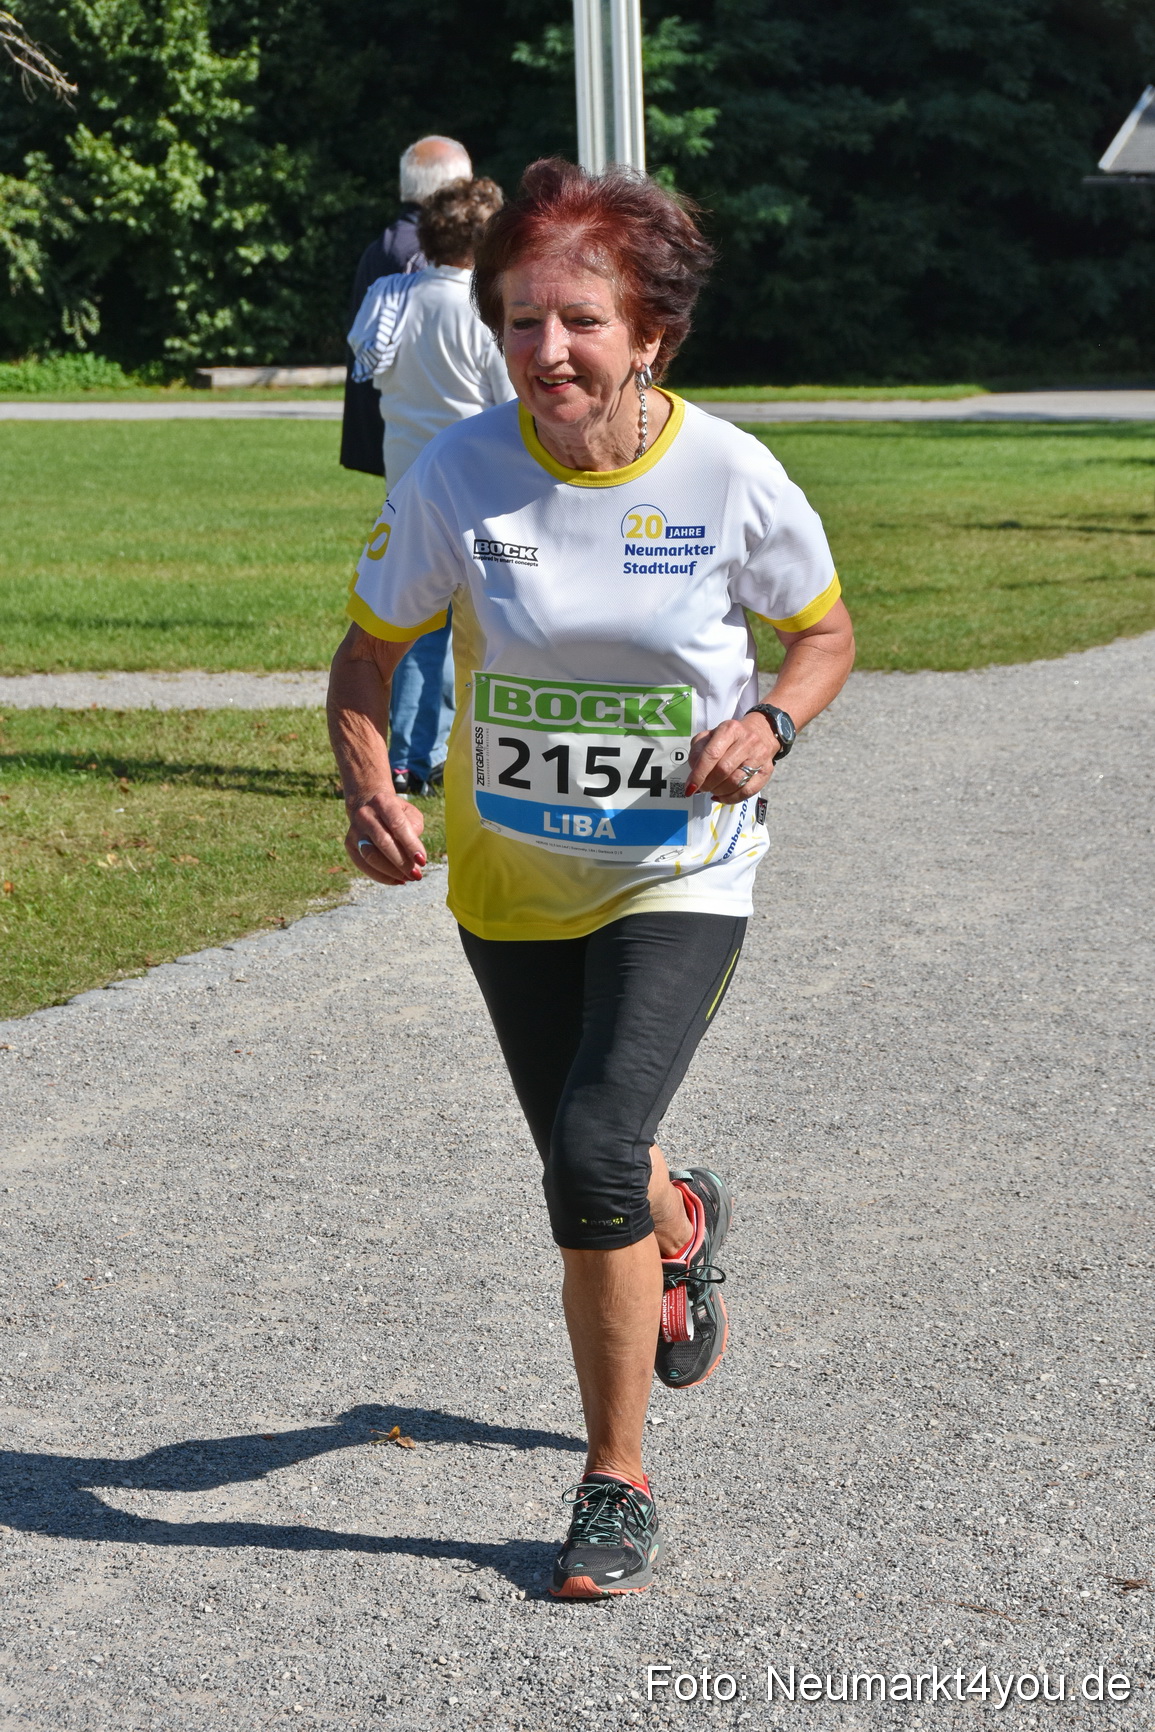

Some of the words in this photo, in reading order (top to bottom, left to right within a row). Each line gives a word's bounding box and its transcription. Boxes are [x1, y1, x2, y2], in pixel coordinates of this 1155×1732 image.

[625, 514, 663, 539] 20
[668, 527, 702, 538] JAHRE
[473, 538, 539, 562] BOCK
[624, 543, 716, 557] Neumarkter
[623, 560, 697, 575] Stadtlauf
[488, 679, 676, 731] BOCK
[498, 737, 667, 798] 2154
[674, 751, 685, 761] D
[543, 811, 617, 840] LIBA
[717, 820, 743, 861] ember
